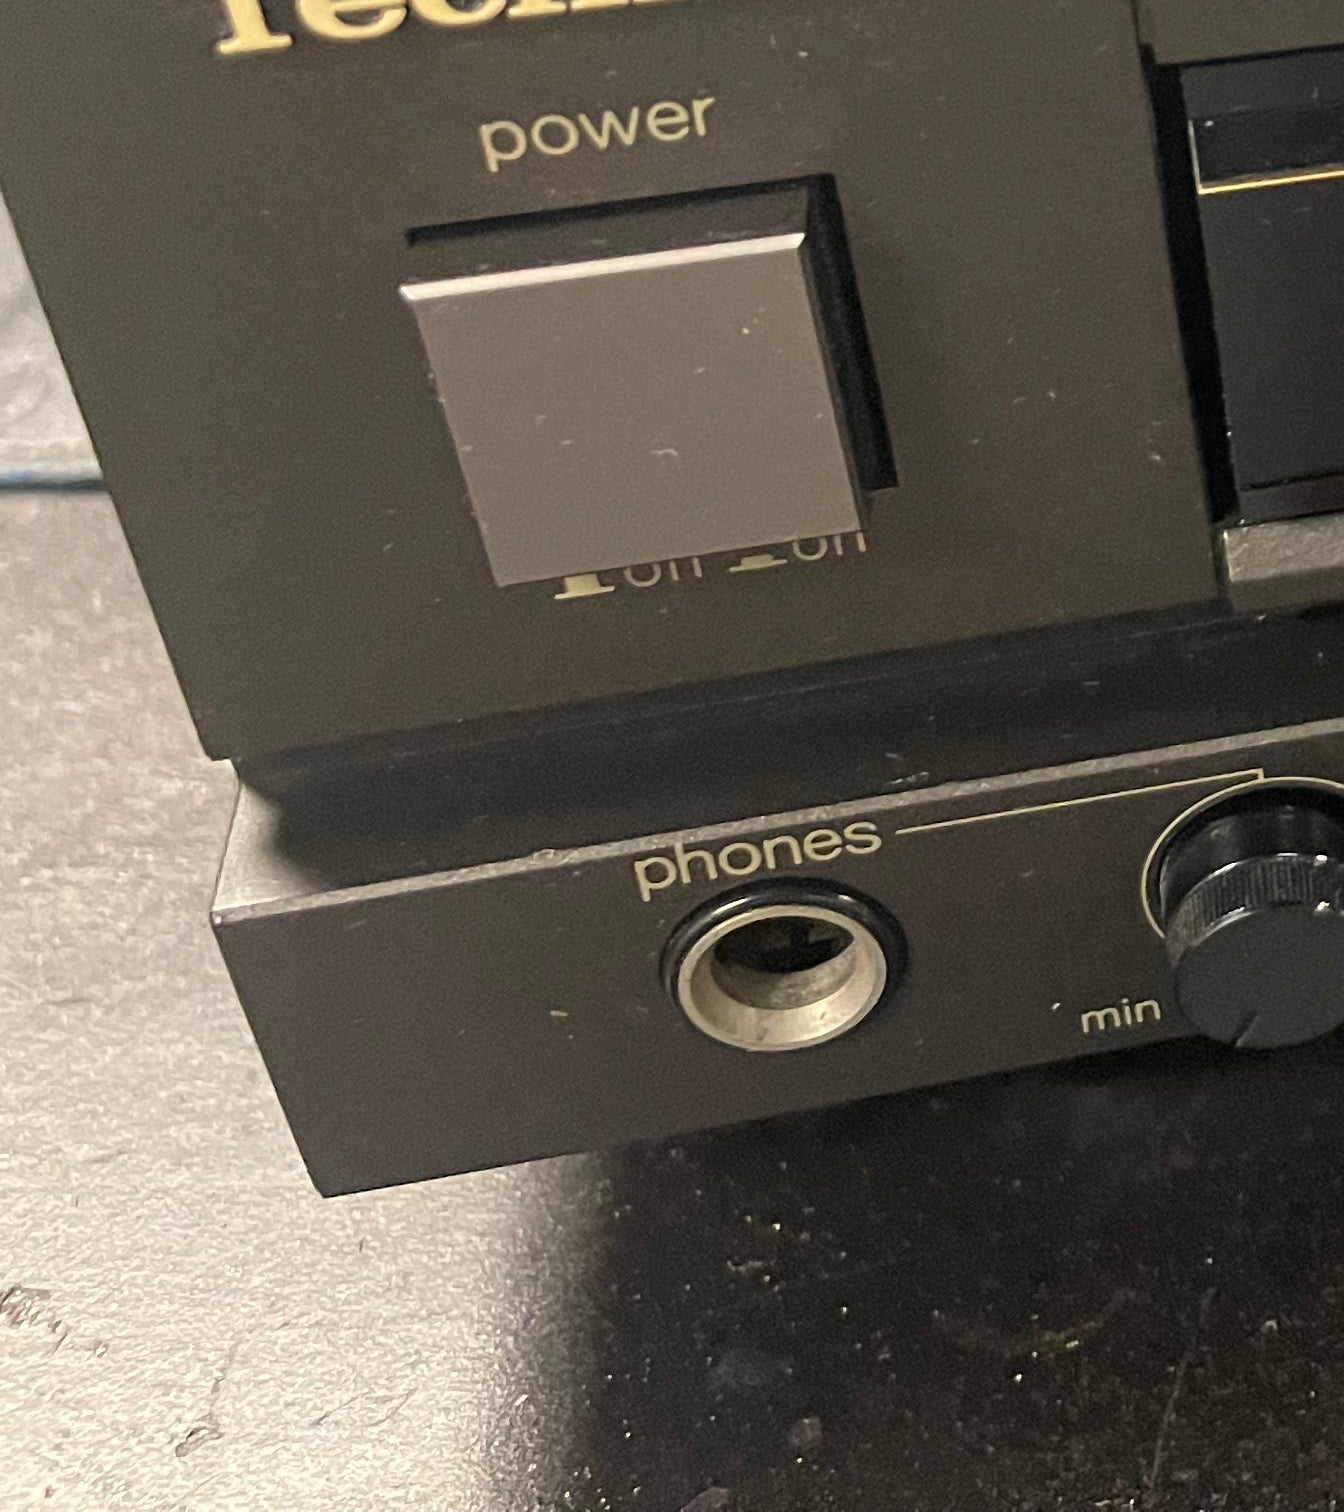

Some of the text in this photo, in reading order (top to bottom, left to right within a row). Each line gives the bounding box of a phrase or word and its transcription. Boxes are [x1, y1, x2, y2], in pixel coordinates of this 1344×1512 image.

[478, 95, 717, 173] power
[634, 819, 883, 902] phones
[1079, 996, 1163, 1034] min
